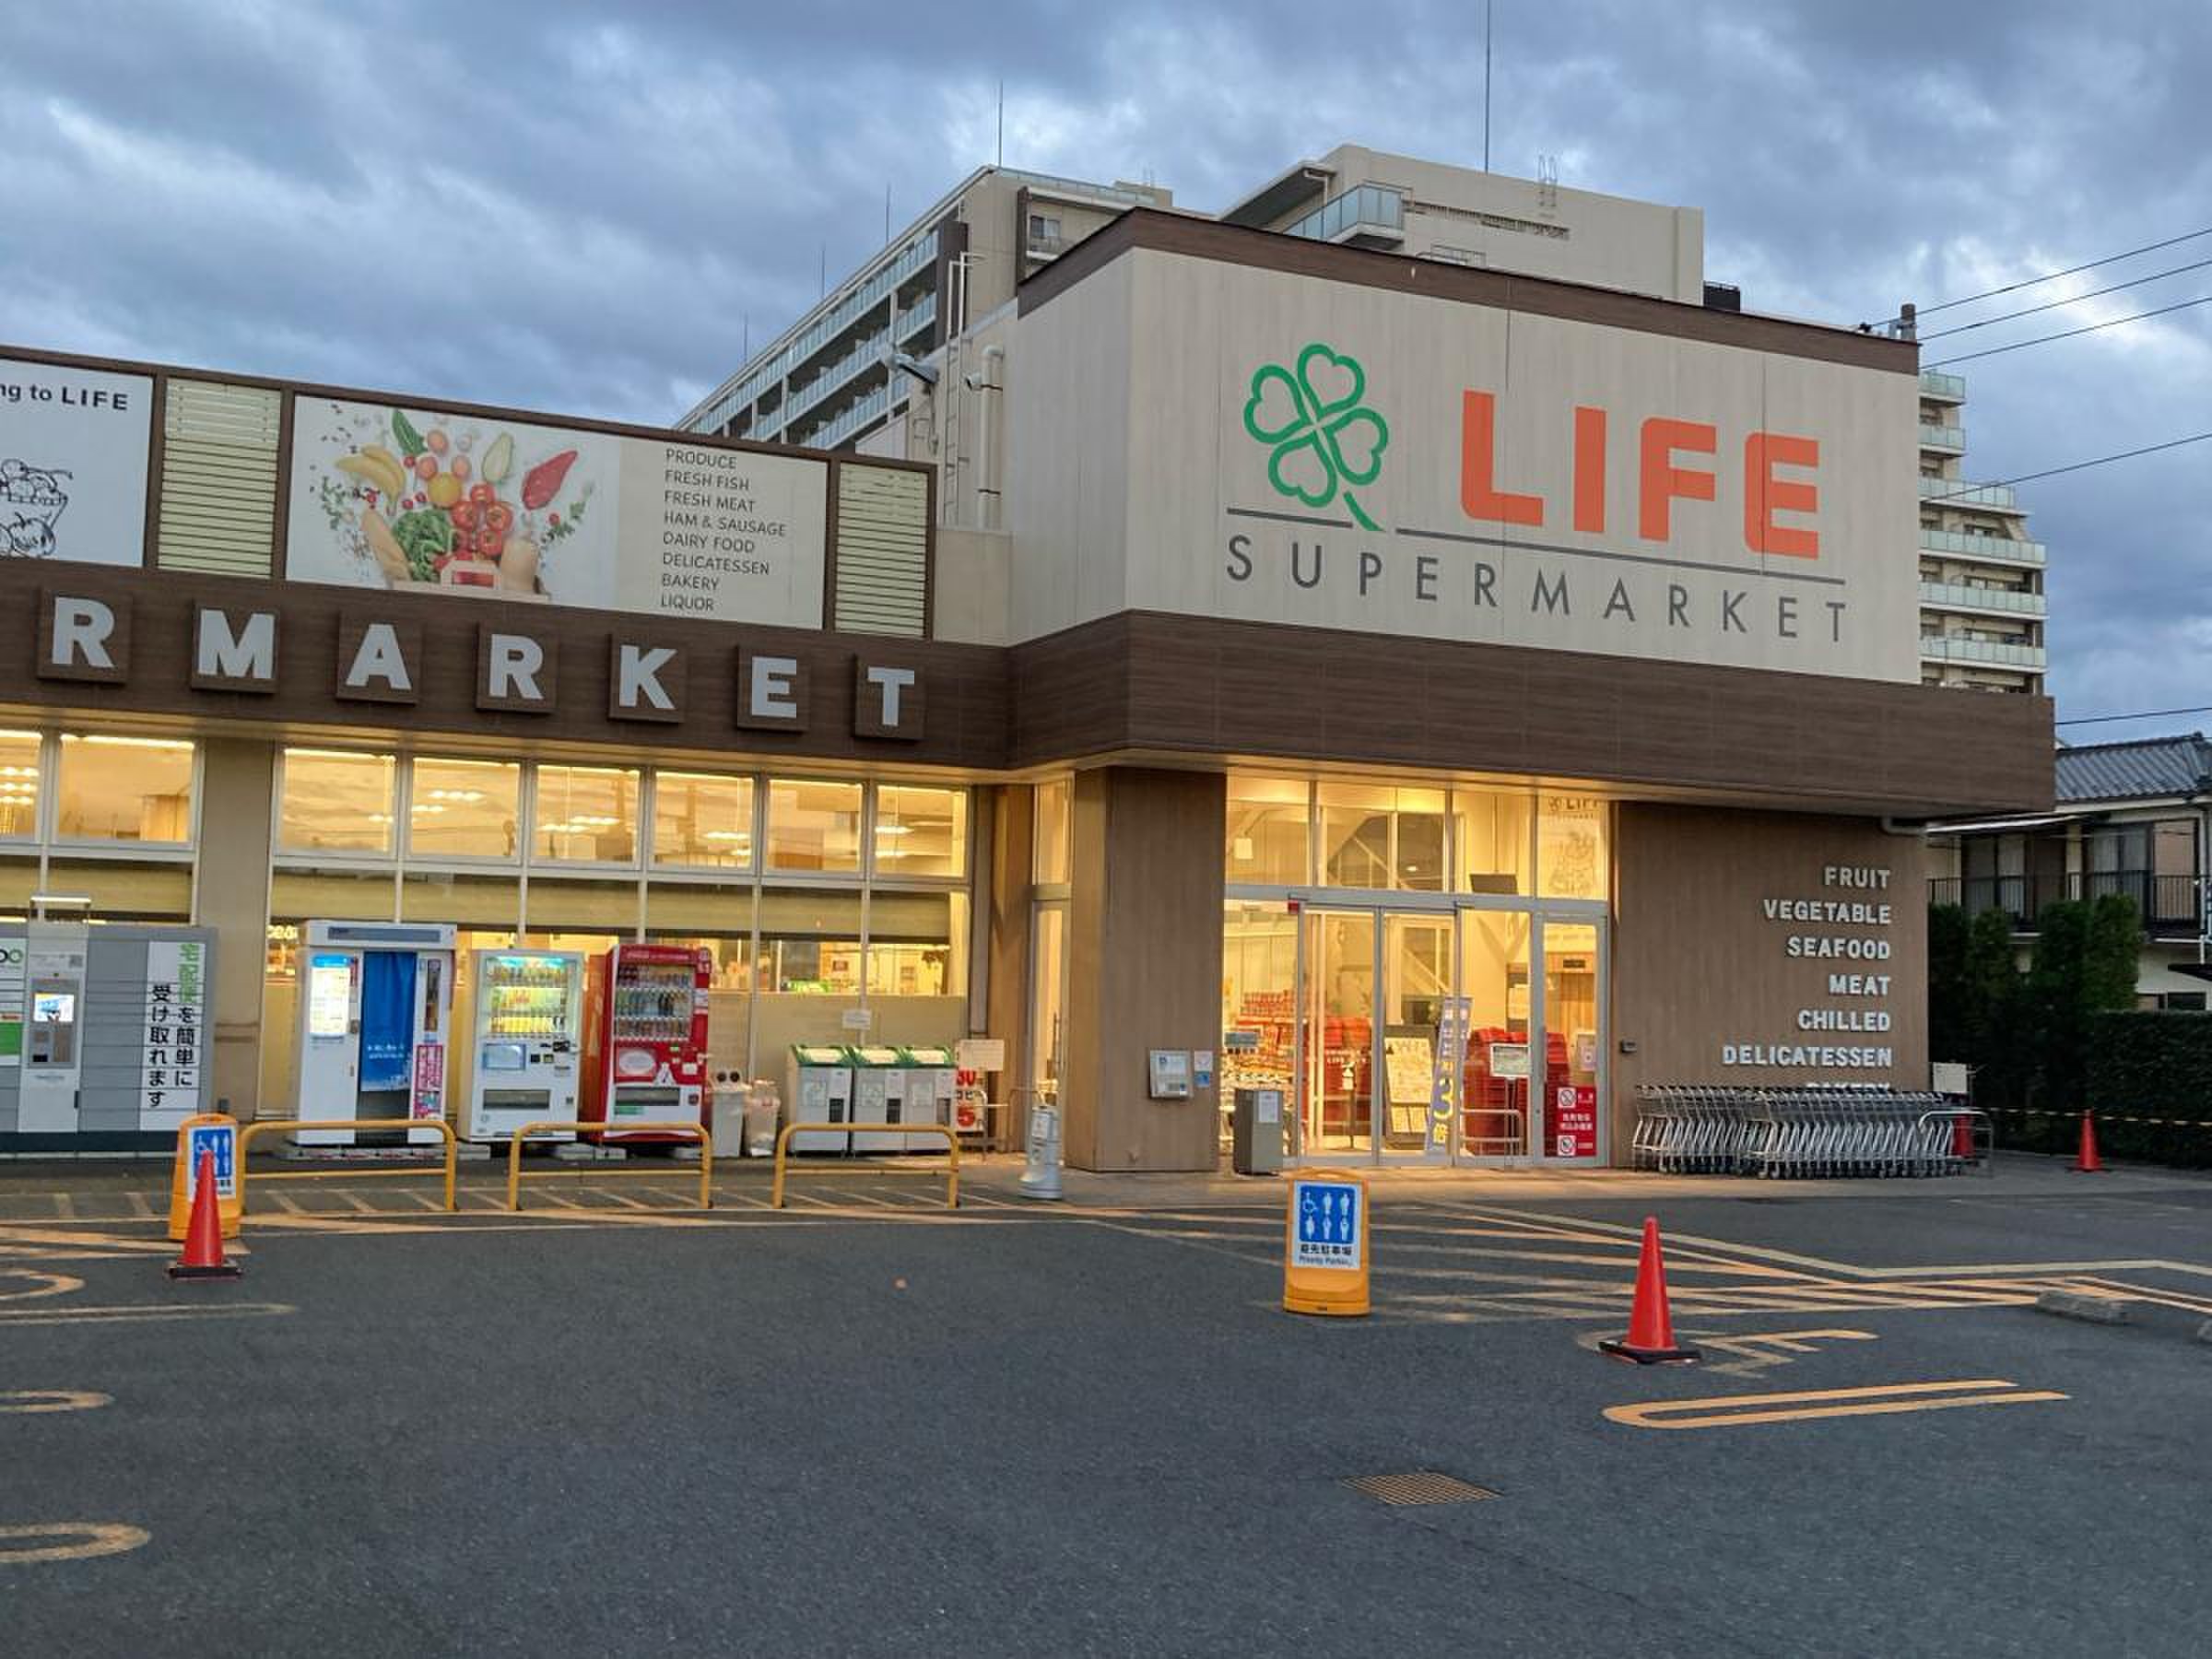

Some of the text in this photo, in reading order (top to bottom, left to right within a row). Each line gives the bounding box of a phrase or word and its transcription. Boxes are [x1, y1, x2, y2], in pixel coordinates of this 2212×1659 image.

[29, 383, 53, 401] to
[61, 385, 129, 411] LIFE
[665, 447, 737, 471] PRODUCE
[664, 469, 750, 491] FRESH FISH
[1461, 388, 1819, 559] LIFE
[664, 490, 756, 513] FRESH MEAT
[663, 512, 788, 538] HAM & SAUSAGE
[662, 532, 755, 554] DAIRY FOOD
[662, 552, 770, 577] DELICATESSEN
[661, 573, 721, 592] BAKERY
[1225, 533, 1846, 643] SUPERMARKET
[660, 594, 715, 613] LIQUOR
[1824, 865, 1892, 890] FRUIT
[1762, 898, 1892, 925] VEGETABLE
[1785, 935, 1892, 960] SEAFOOD
[1828, 974, 1892, 996] MEAT
[1797, 1008, 1891, 1032] CHILLED
[147, 983, 171, 1107] 受け取れます
[1722, 1044, 1893, 1067] DELICATESSEN
